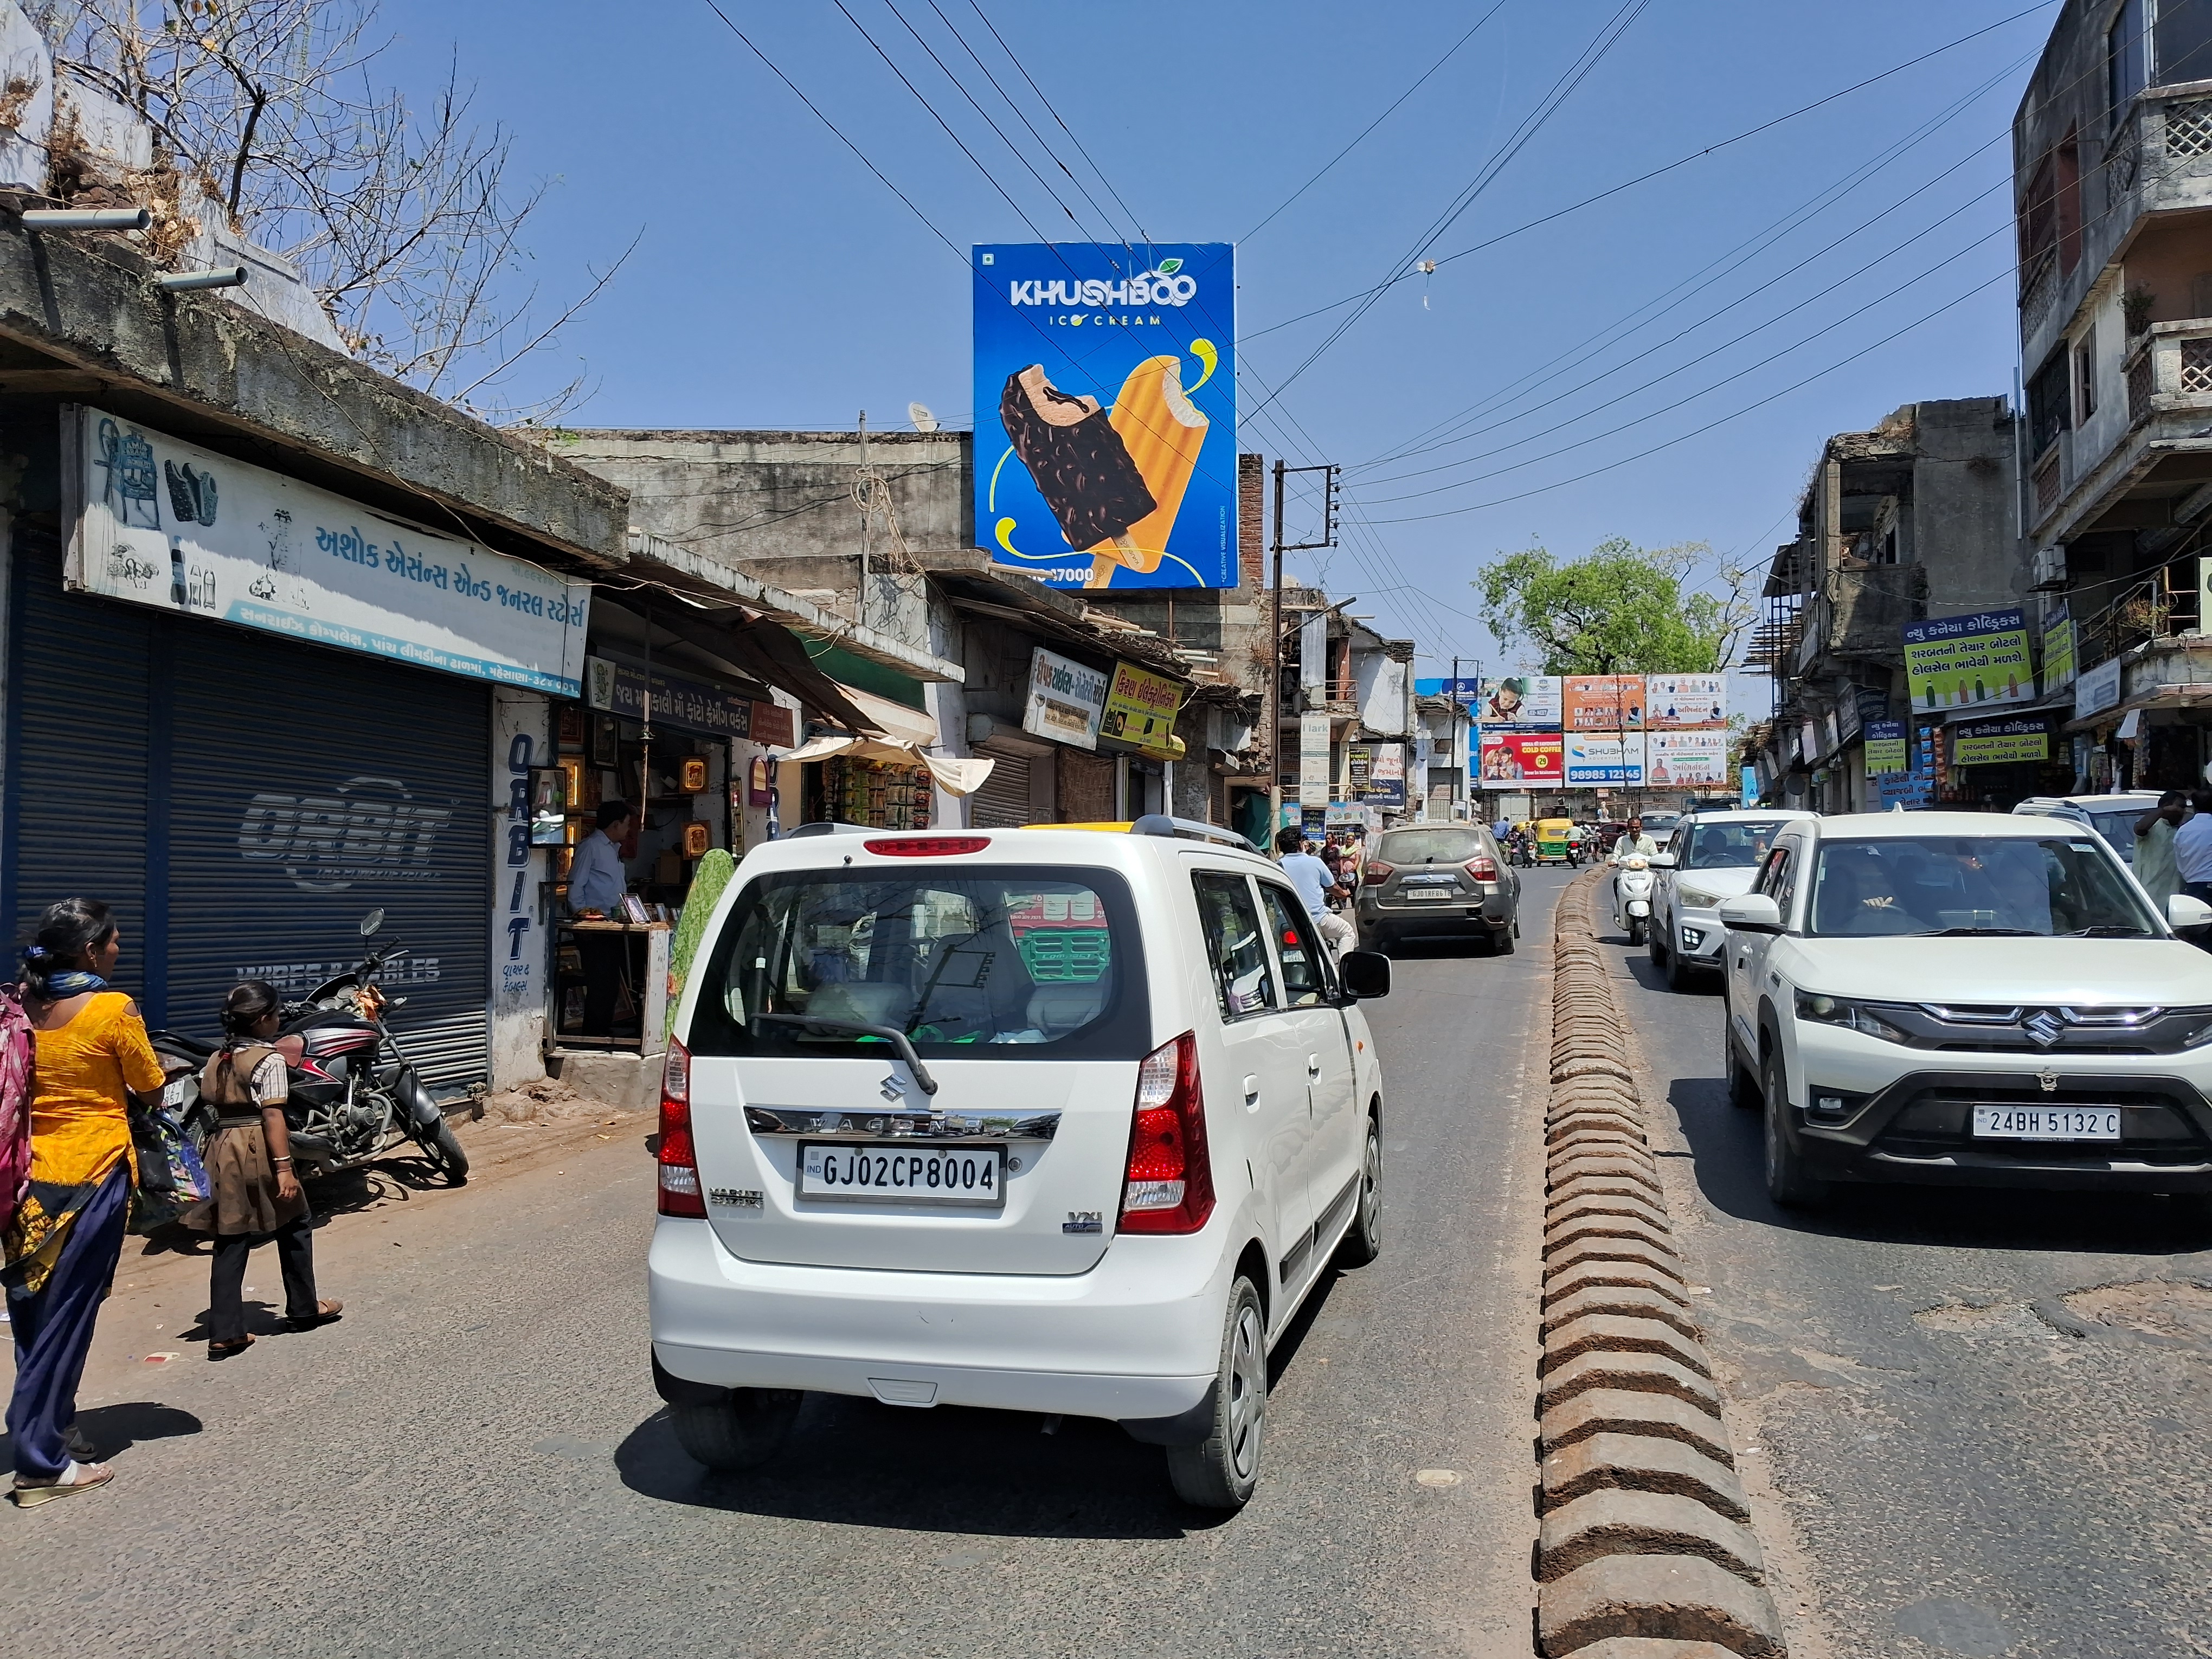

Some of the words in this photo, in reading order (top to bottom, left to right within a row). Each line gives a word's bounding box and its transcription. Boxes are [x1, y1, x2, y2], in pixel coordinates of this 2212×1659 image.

[1011, 271, 1197, 307] KHUSHBOO
[1094, 315, 1160, 326] CREAM
[316, 526, 378, 568] અશોક
[454, 563, 491, 601] એન્ડ
[497, 584, 543, 617] જનરલ
[1928, 622, 1962, 635] કનૈયા
[1911, 643, 1956, 659] શરબતની
[1959, 641, 1985, 653] તૈયાર
[1990, 634, 2021, 649] બોટલો
[1912, 660, 1950, 676] હોલસેલ
[1673, 762, 1710, 771] અભિનંદન
[1571, 770, 1606, 780] 98985
[1991, 1112, 2039, 1131] 24BH
[2048, 1113, 2097, 1133] 5132
[2107, 1114, 2116, 1133] C
[807, 1166, 821, 1174] IND
[823, 1154, 994, 1192] GJ02CP8004
[709, 1187, 764, 1197] MARUTI
[710, 1197, 764, 1208] SUZUKI
[1068, 1211, 1102, 1224] VXI
